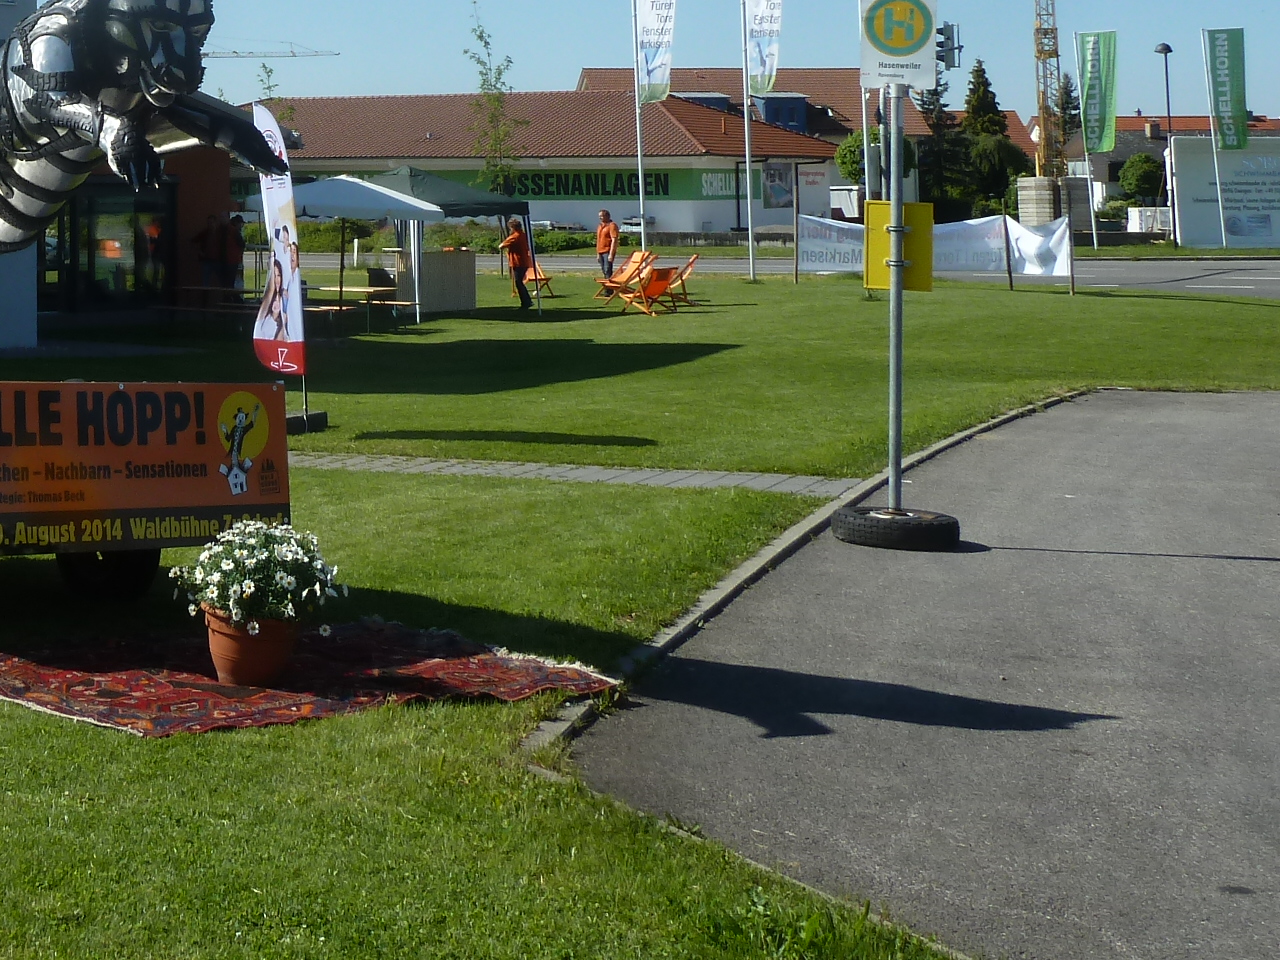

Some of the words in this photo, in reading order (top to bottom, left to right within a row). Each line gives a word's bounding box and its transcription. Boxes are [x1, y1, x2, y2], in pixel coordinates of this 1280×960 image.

[878, 61, 922, 70] Hasenweiler
[1086, 35, 1100, 149] SCHELLHORN
[1215, 33, 1238, 146] SCHELLHORN
[76, 390, 207, 447] HOPP!
[45, 462, 111, 481] Nachbarn
[125, 460, 208, 480] Sensationen
[27, 490, 62, 504] Thomas
[64, 490, 85, 503] Beck
[14, 521, 76, 547] August
[81, 518, 122, 541] 2014
[130, 515, 220, 541] Waldbühne
